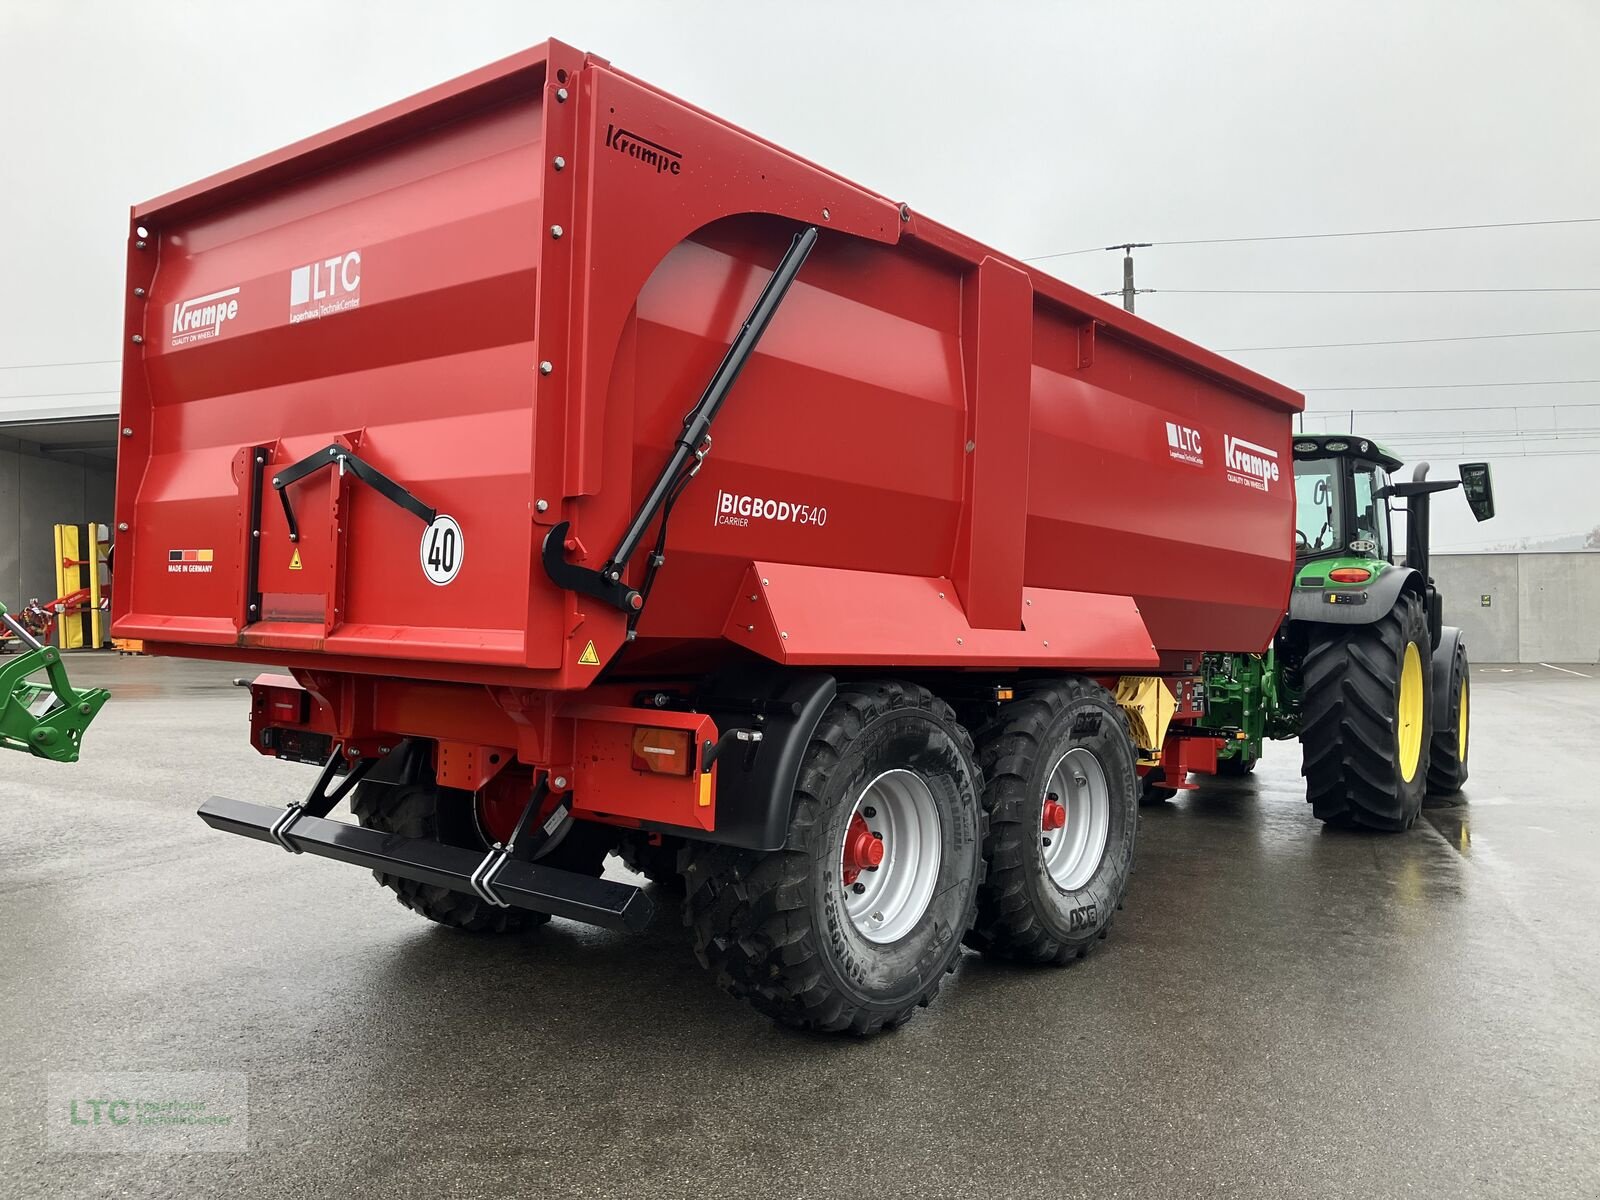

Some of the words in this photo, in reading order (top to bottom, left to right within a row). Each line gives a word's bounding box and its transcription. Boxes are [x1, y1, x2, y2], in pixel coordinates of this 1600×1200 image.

[606, 123, 682, 175] Krampe
[313, 251, 361, 300] LTC
[172, 286, 240, 336] Krampe
[172, 335, 189, 346] QUALITY
[198, 330, 215, 340] WHEELS
[1177, 425, 1202, 454] LTC
[1224, 434, 1279, 492] Krampe
[1227, 473, 1244, 485] QUALITY
[1251, 480, 1265, 491] WHEELS
[719, 515, 749, 527] CARRIER
[427, 527, 455, 573] 40
[168, 564, 182, 572] MADE
[188, 564, 213, 573] GERMANY
[1069, 904, 1098, 932] BKT
